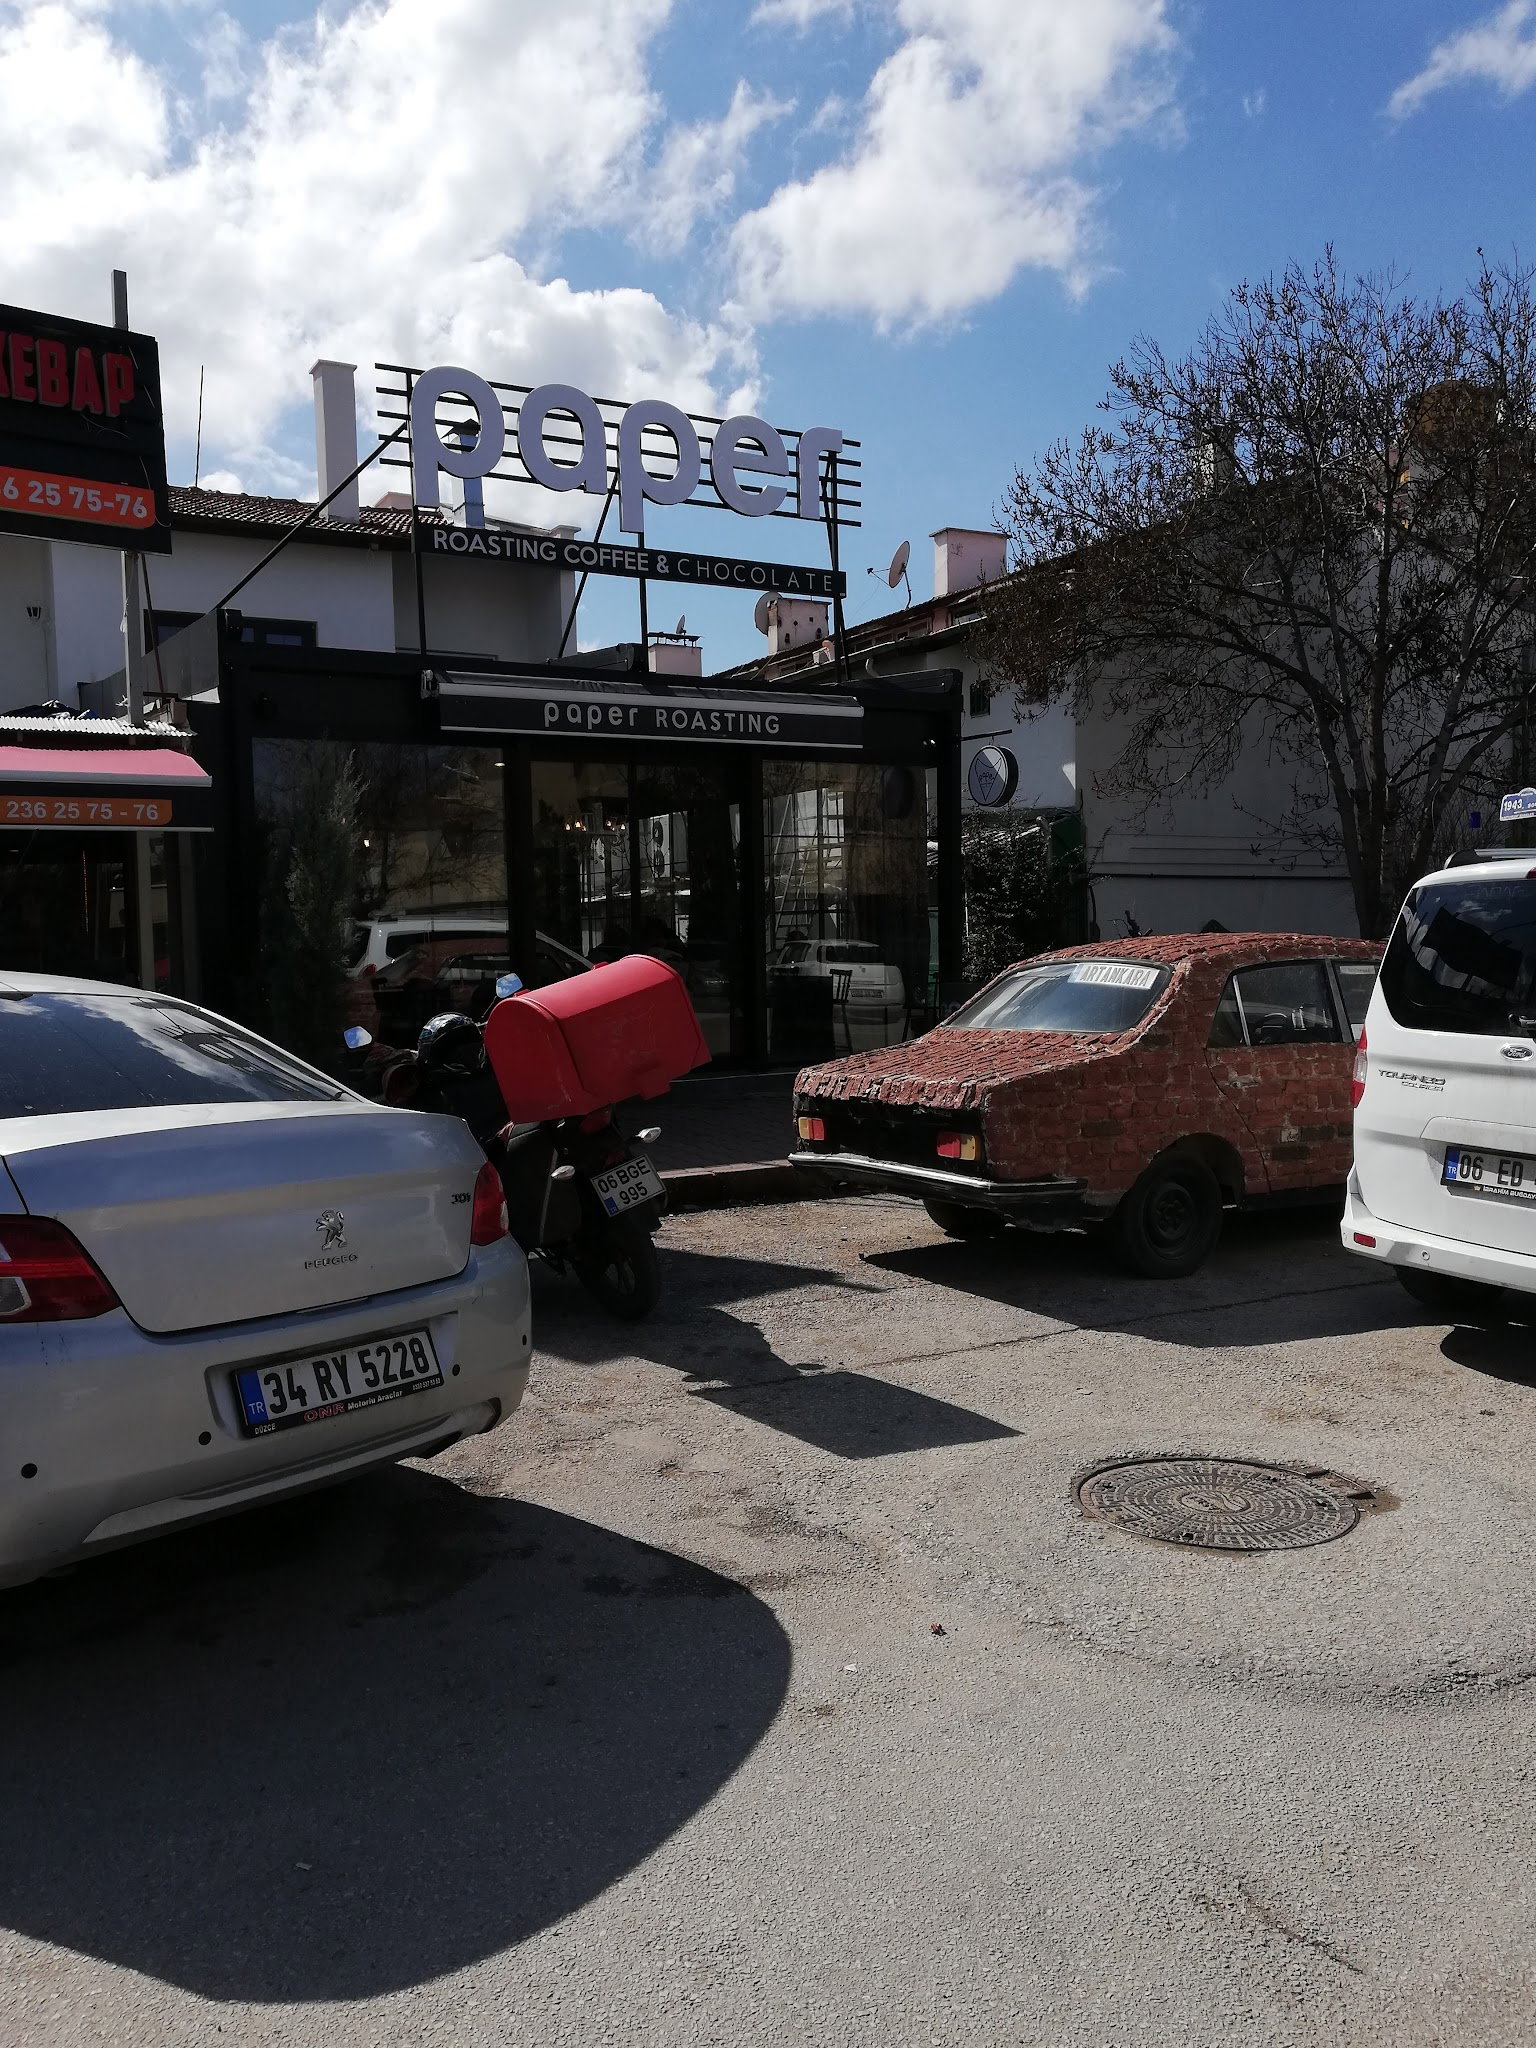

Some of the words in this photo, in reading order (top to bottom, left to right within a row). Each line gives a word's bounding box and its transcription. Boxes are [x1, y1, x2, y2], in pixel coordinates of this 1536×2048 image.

[411, 366, 843, 532] paper
[0, 477, 19, 499] 6
[28, 480, 62, 505] 25
[69, 486, 148, 518] 75-76
[433, 529, 557, 562] ROASTING
[564, 544, 649, 572] COFFEE
[656, 554, 670, 574] &
[677, 558, 834, 592] CHOCOLATE
[544, 701, 639, 730] paper
[655, 709, 781, 735] ROASTING
[6, 801, 47, 819] 236
[54, 802, 80, 819] 25
[87, 803, 113, 820] 75
[132, 804, 159, 820] 76
[1079, 965, 1151, 987] ARTANKARA
[597, 1174, 618, 1194] 06
[615, 1159, 651, 1185] BGE
[1447, 1166, 1457, 1175] TR
[1459, 1154, 1484, 1181] 06
[1497, 1158, 1524, 1187] ED
[619, 1181, 648, 1205] 995
[249, 1401, 265, 1415] TR
[263, 1368, 308, 1415] 34
[312, 1354, 352, 1402] RY
[357, 1337, 431, 1389] 5228
[303, 1402, 346, 1423] ONR
